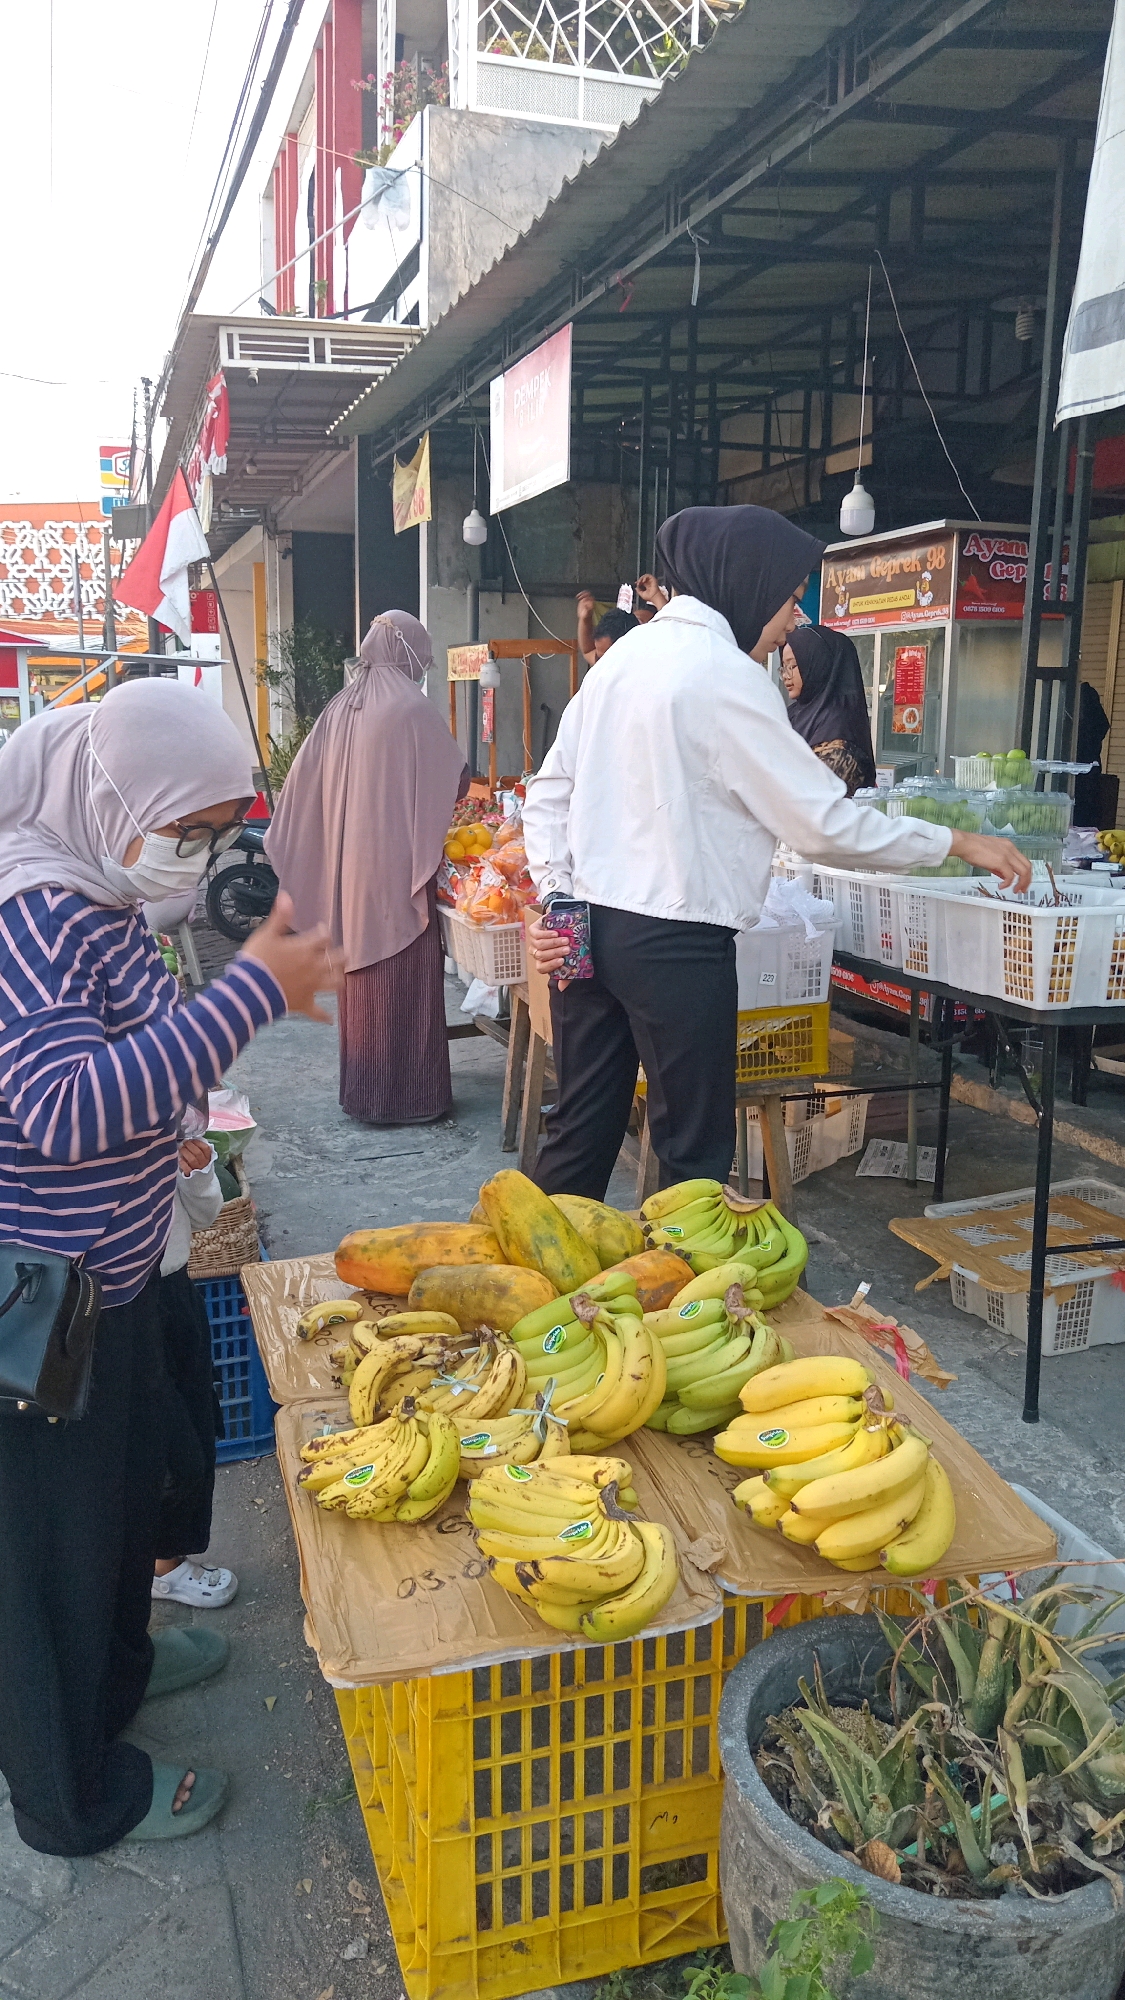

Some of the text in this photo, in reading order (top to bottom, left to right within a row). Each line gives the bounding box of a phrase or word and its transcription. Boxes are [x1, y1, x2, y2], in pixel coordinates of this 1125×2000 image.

[513, 366, 552, 417] PEMPEK
[825, 545, 946, 589] Ayam Geprek 98
[963, 533, 1028, 562] Ayam
